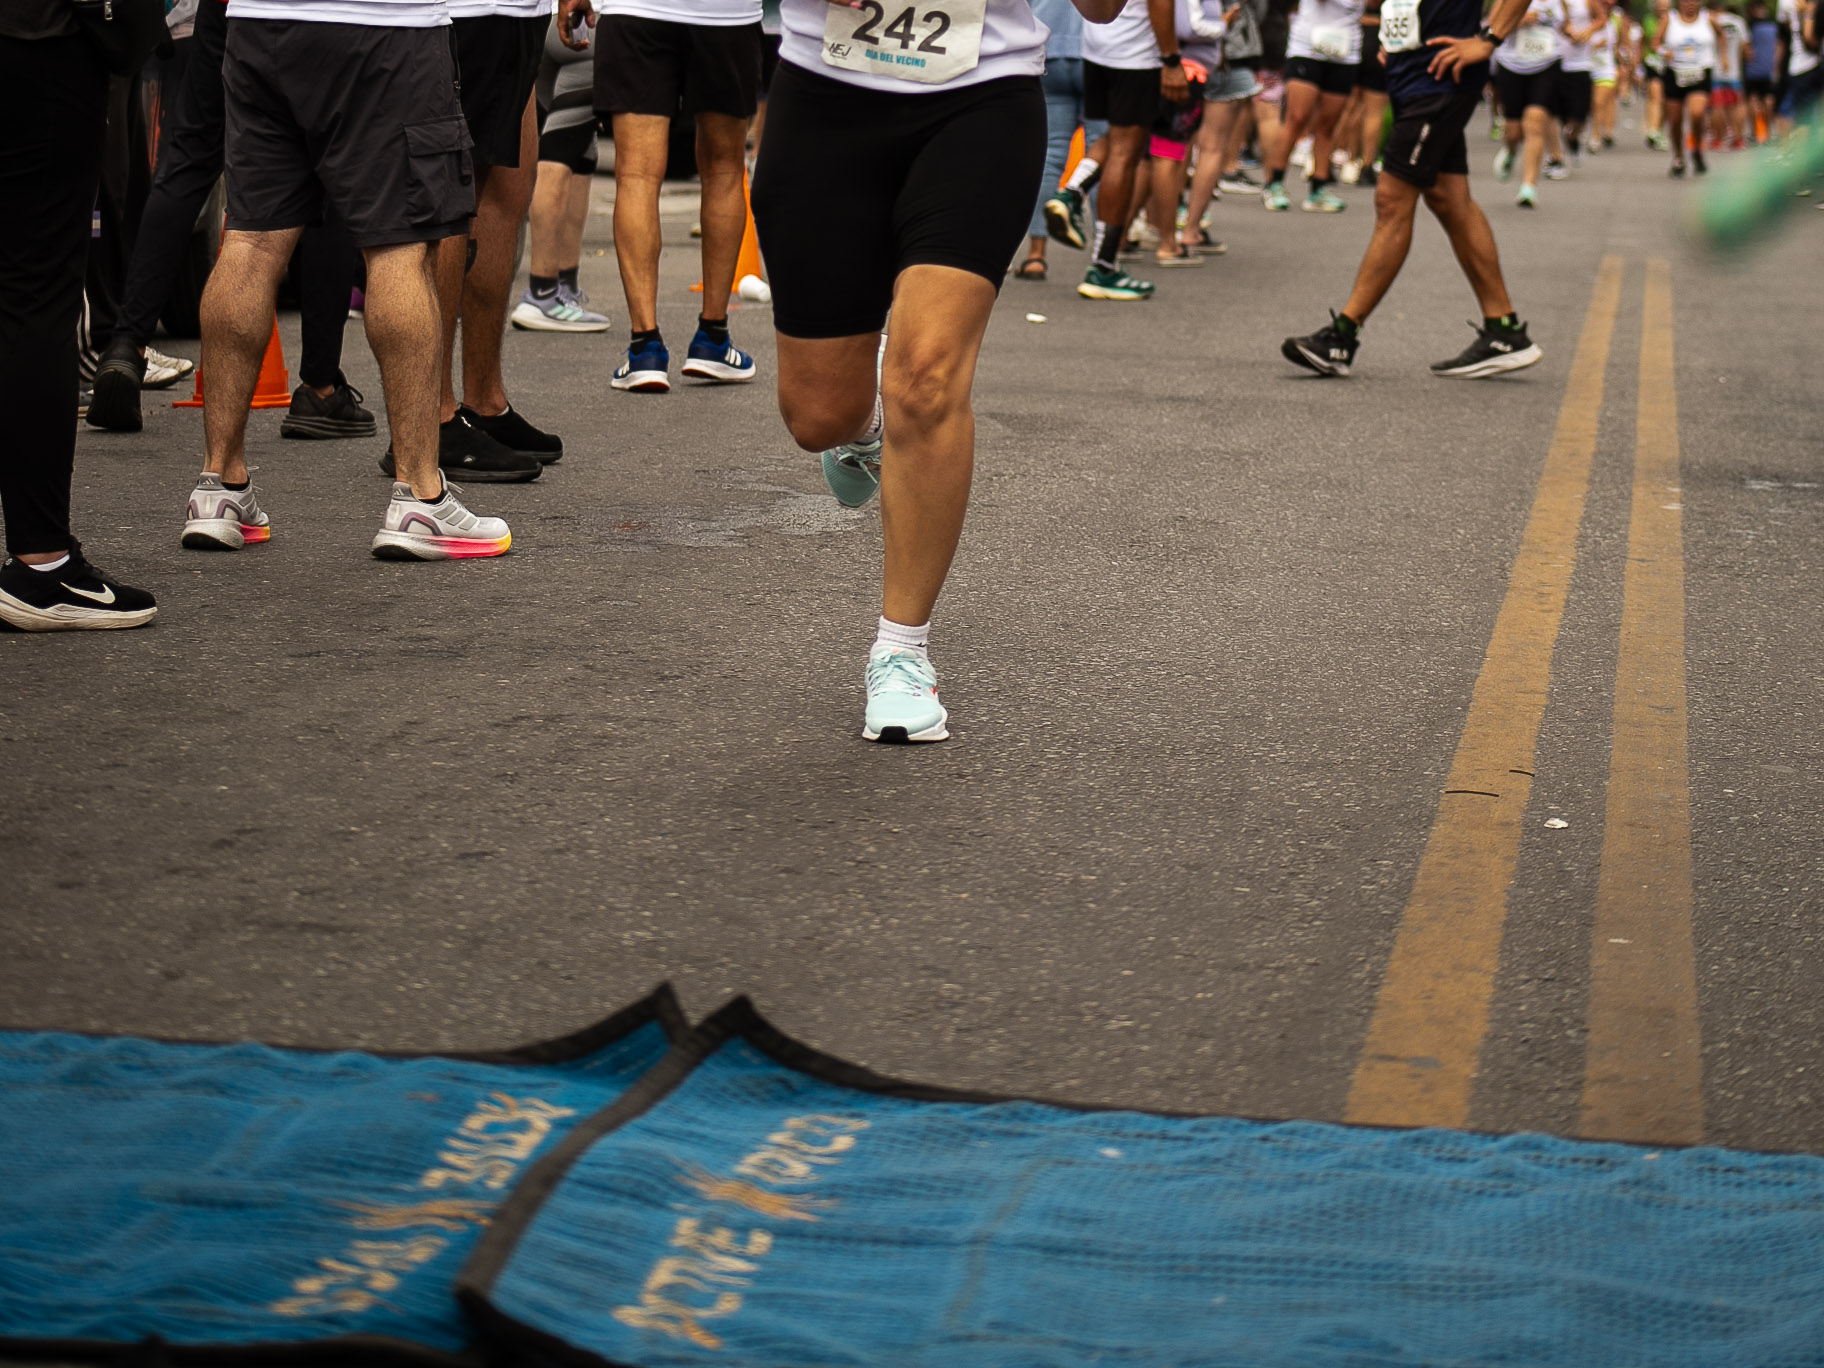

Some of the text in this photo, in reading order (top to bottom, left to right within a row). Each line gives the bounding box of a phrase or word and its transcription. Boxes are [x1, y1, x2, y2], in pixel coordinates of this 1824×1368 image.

[851, 0, 951, 56] 242
[879, 50, 895, 63] DEL
[895, 54, 926, 69] VECINO
